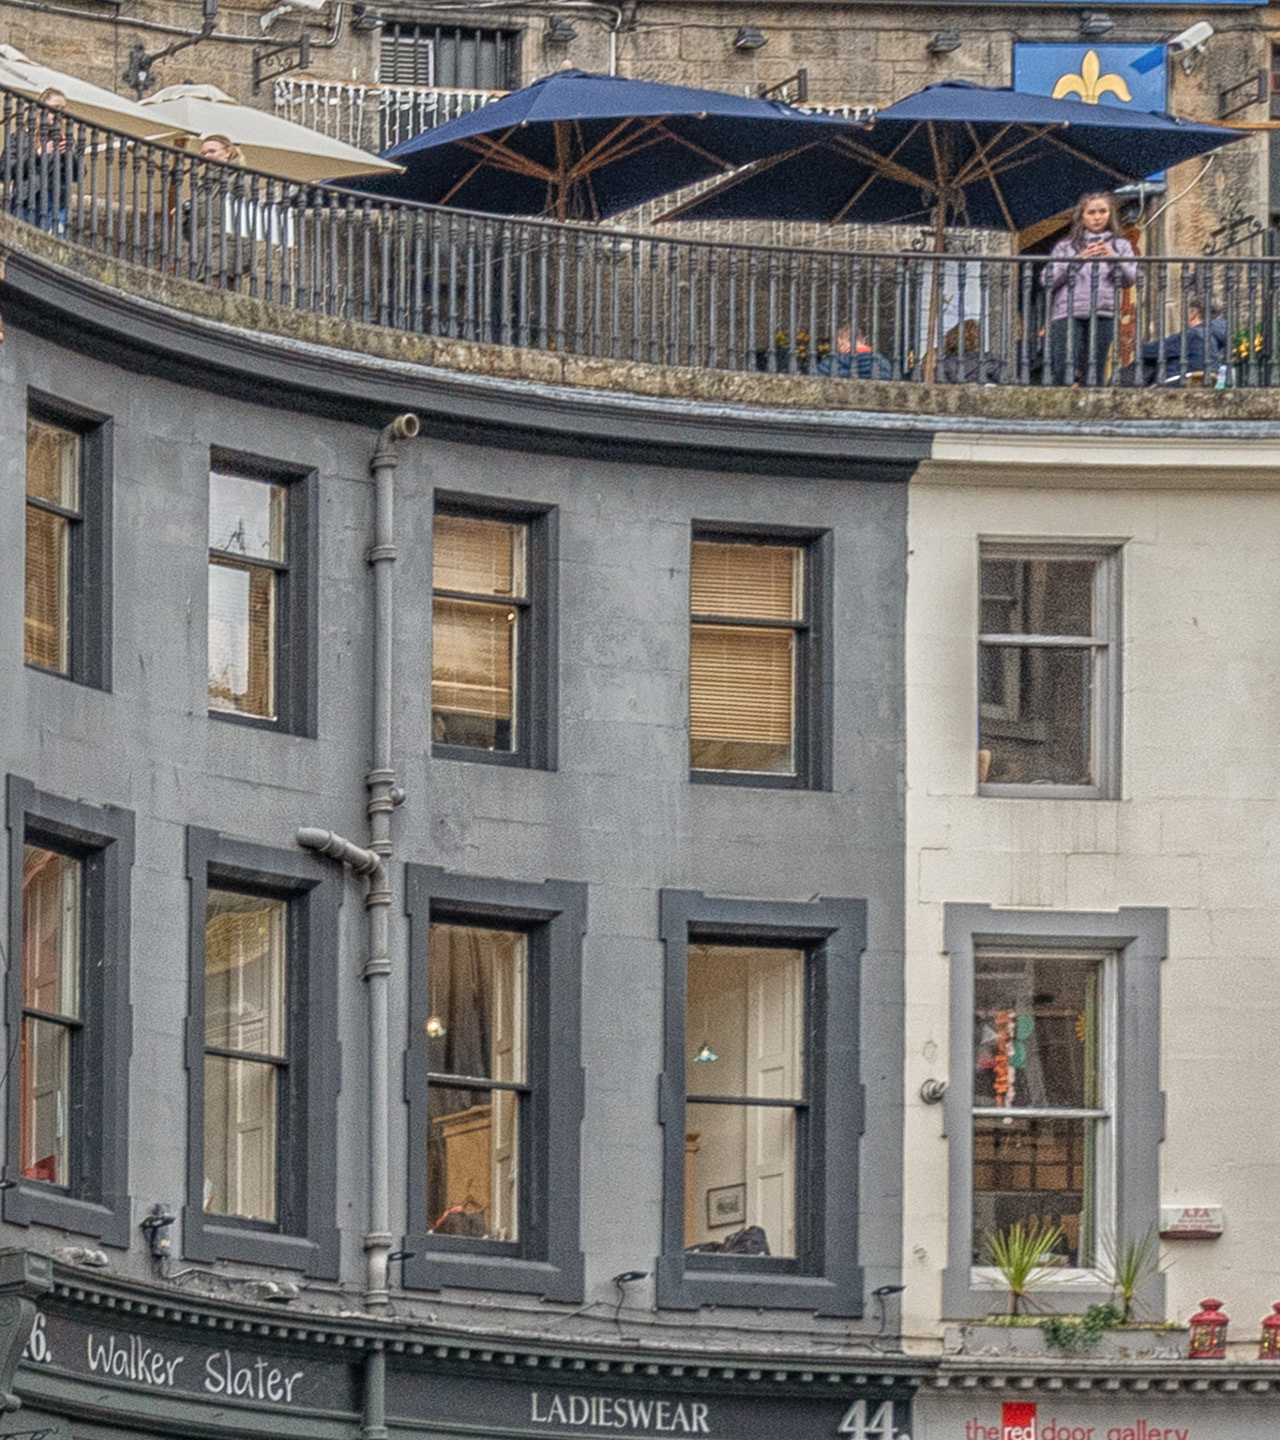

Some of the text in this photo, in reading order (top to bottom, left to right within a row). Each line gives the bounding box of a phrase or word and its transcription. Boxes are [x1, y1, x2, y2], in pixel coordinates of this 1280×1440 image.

[21, 1312, 304, 1402] 6. Walker Slater
[529, 1392, 710, 1433] LADIESWEAR
